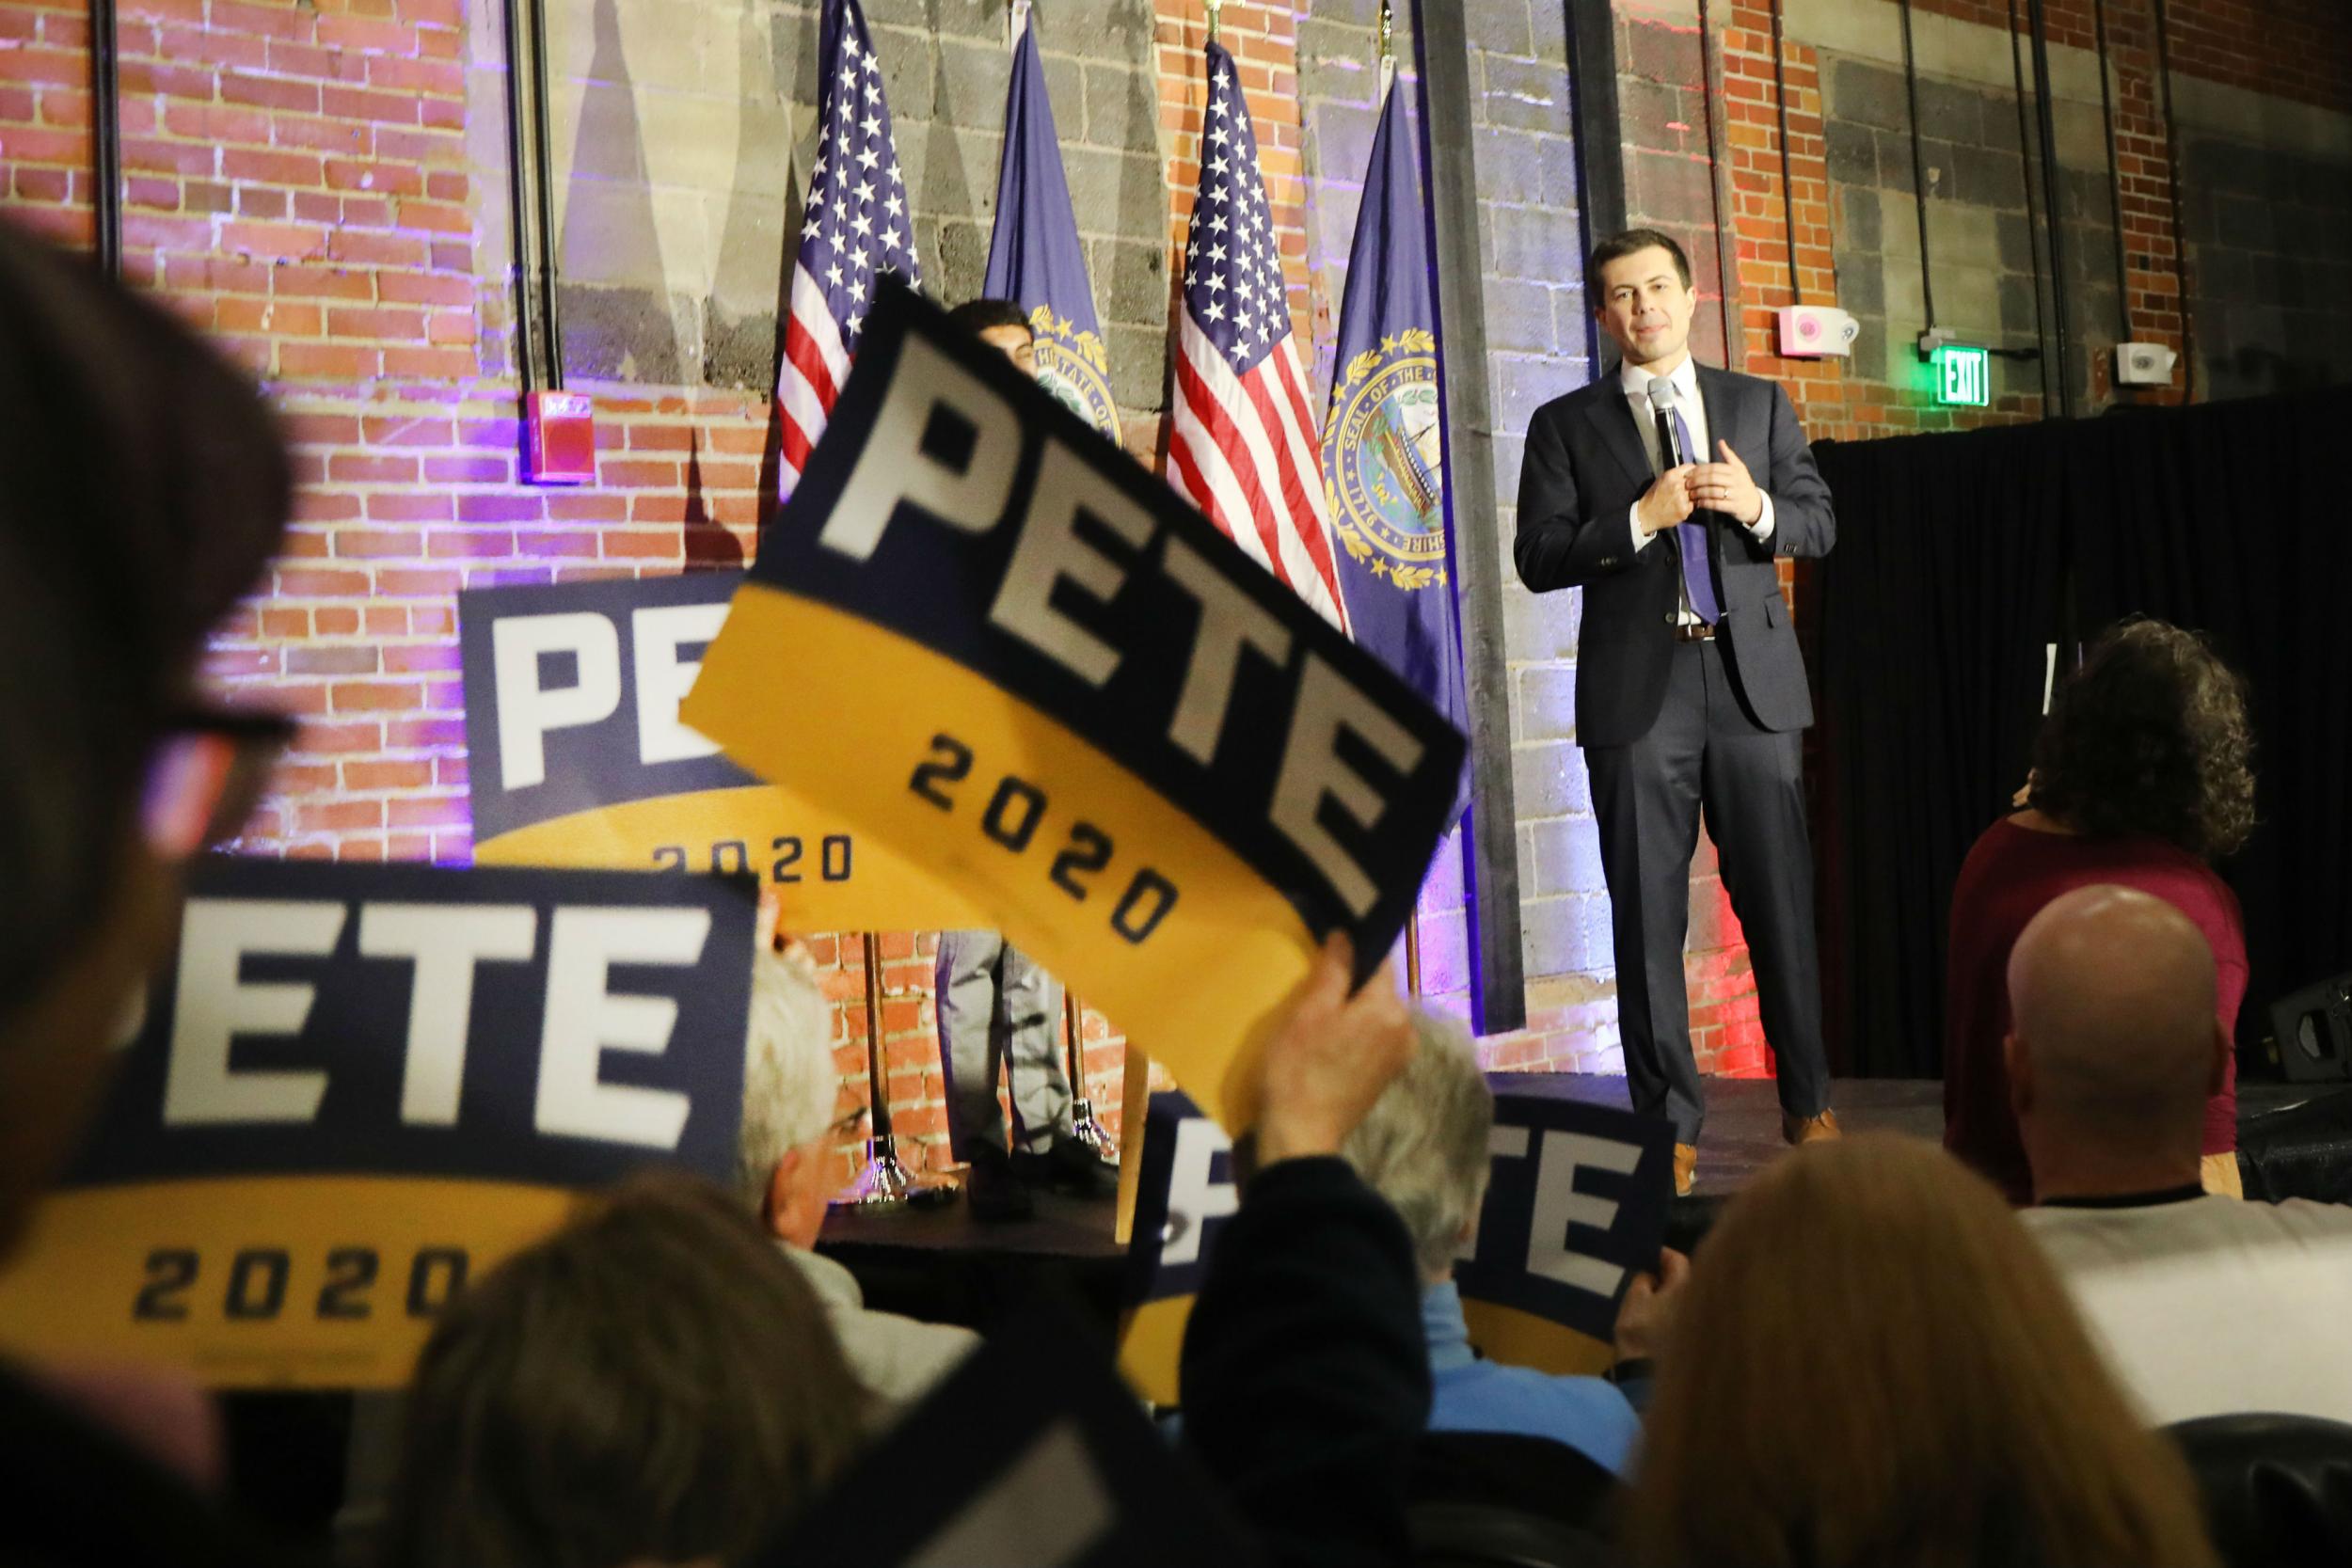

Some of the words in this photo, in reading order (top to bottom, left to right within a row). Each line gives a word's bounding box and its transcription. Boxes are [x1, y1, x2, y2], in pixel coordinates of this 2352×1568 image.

[1056, 356, 1095, 399] TATE
[1344, 408, 1370, 451] SEAL
[1369, 379, 1389, 402] OF
[1397, 366, 1423, 386] THE
[1946, 349, 1981, 403] EXIT
[1349, 486, 1378, 528] 1776
[817, 331, 1427, 921] PETE
[492, 602, 733, 792] PE
[907, 732, 1181, 946] 2020
[161, 896, 712, 1151] ETE
[133, 1247, 469, 1323] 2020
